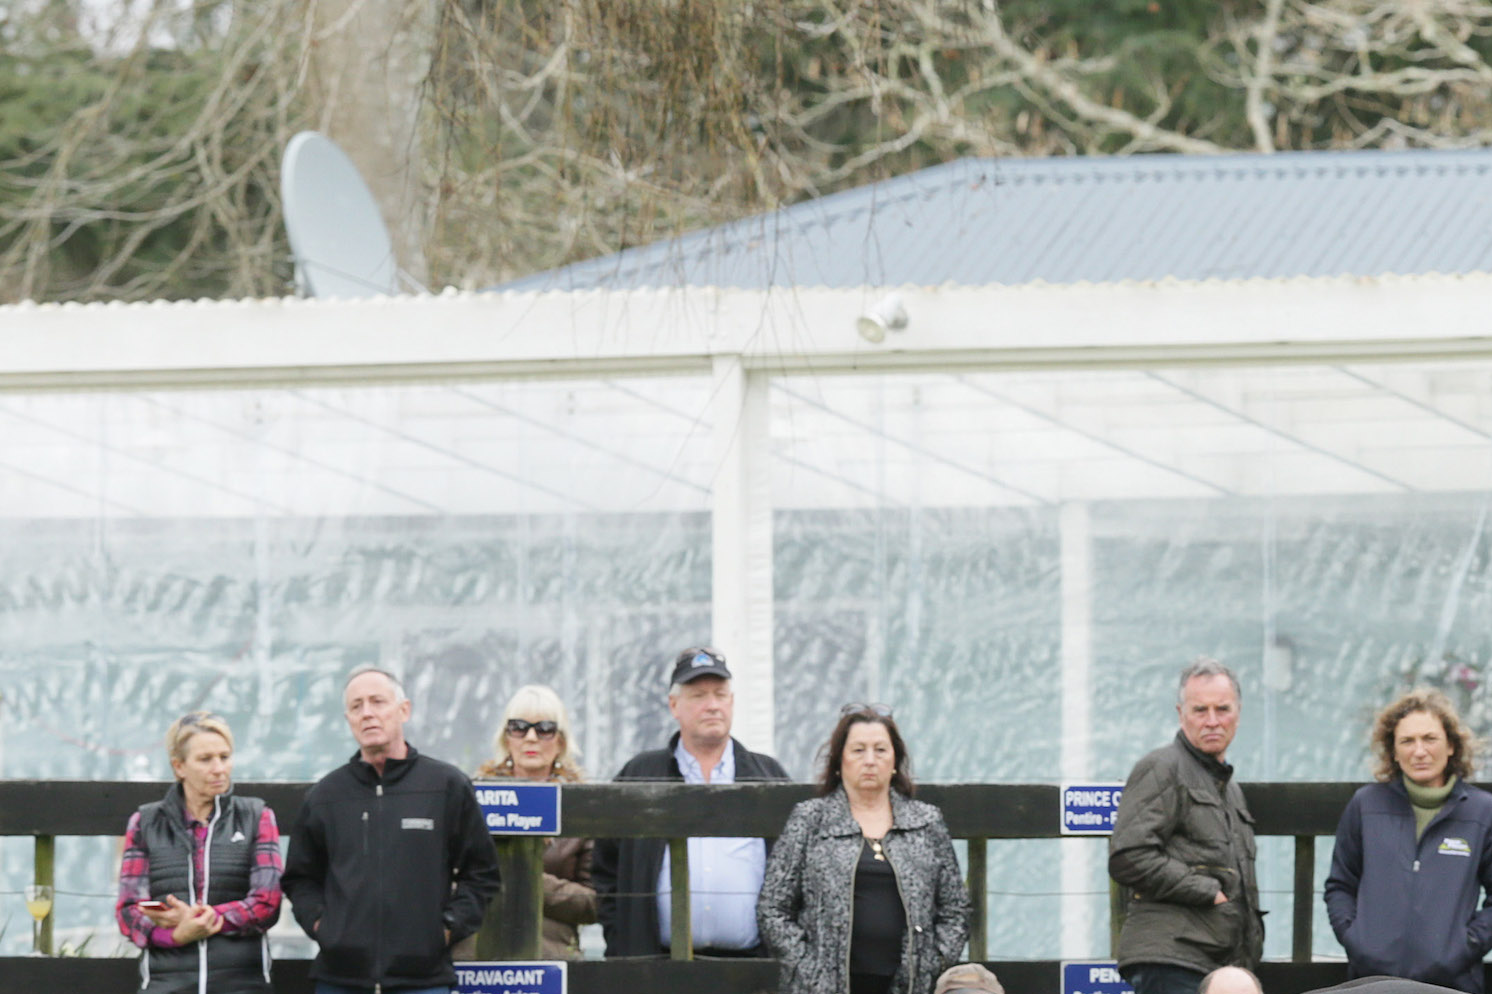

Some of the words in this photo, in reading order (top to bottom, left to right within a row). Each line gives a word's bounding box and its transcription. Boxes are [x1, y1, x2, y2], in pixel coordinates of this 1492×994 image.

[1065, 791, 1111, 807] PRINCE
[506, 812, 543, 830] Player
[1065, 811, 1103, 825] Pentire
[455, 969, 545, 986] TRAVAGANT
